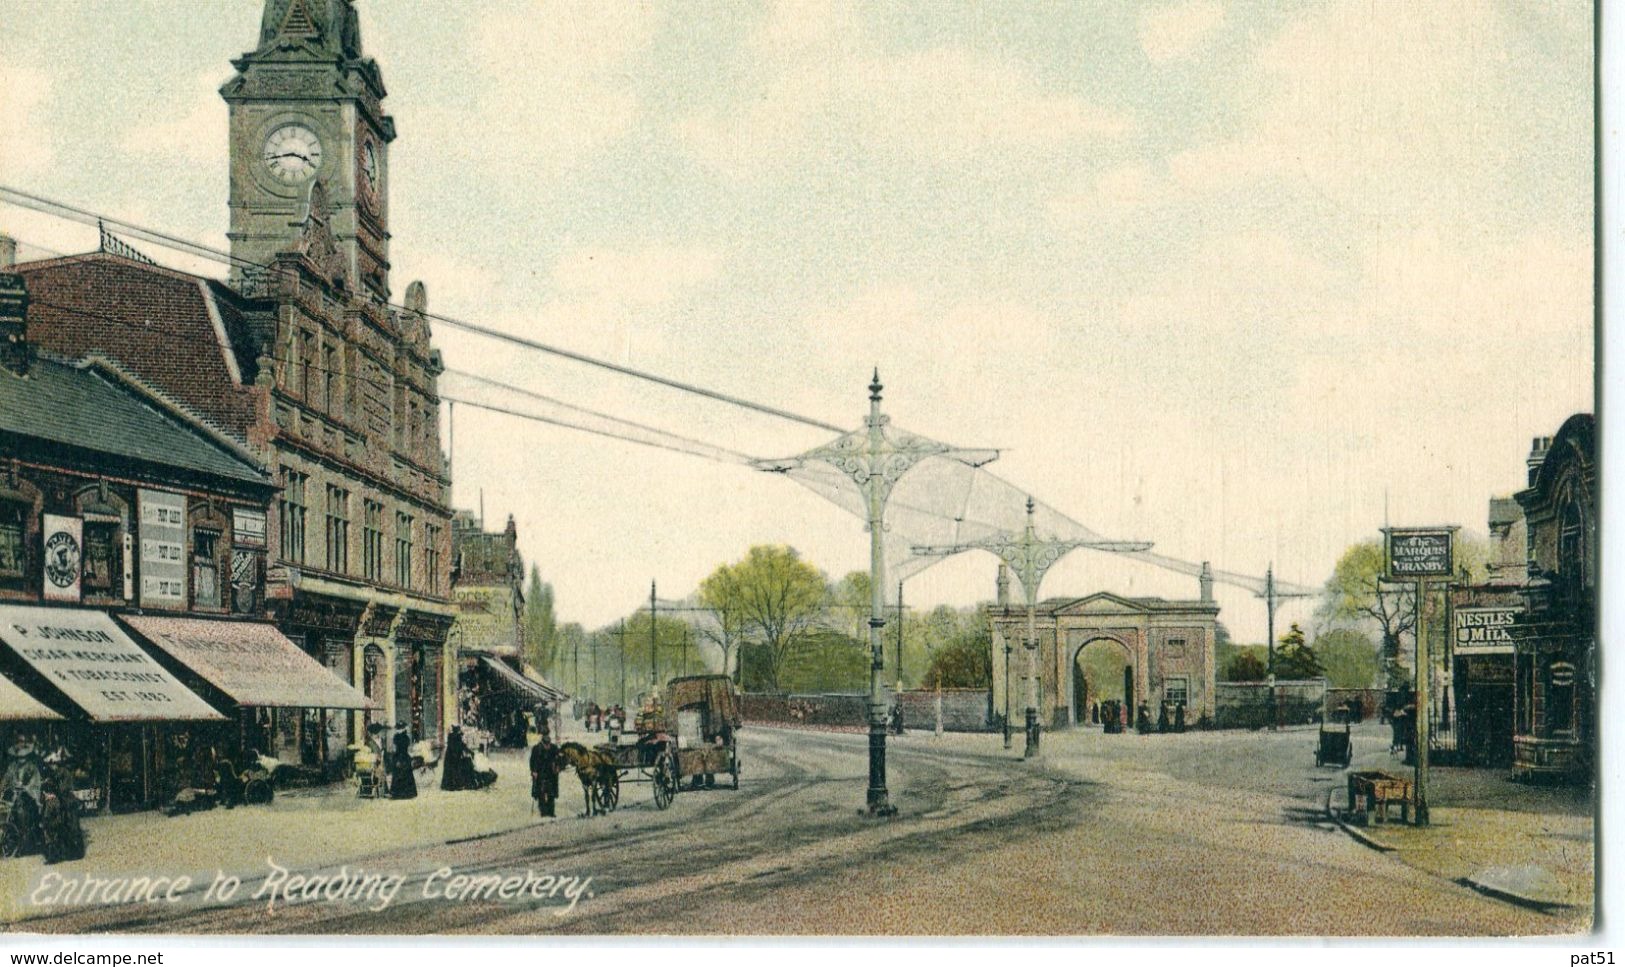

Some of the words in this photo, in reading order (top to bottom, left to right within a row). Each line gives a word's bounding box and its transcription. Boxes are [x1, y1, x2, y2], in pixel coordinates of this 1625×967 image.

[1408, 537, 1431, 546] The
[1394, 546, 1446, 556] MARQUIS
[37, 625, 115, 644] JOHNSON
[1470, 628, 1512, 641] MILK
[23, 649, 73, 661] CIGAR
[73, 650, 150, 664] MERCHANT
[68, 670, 168, 685] TOBACCONIST
